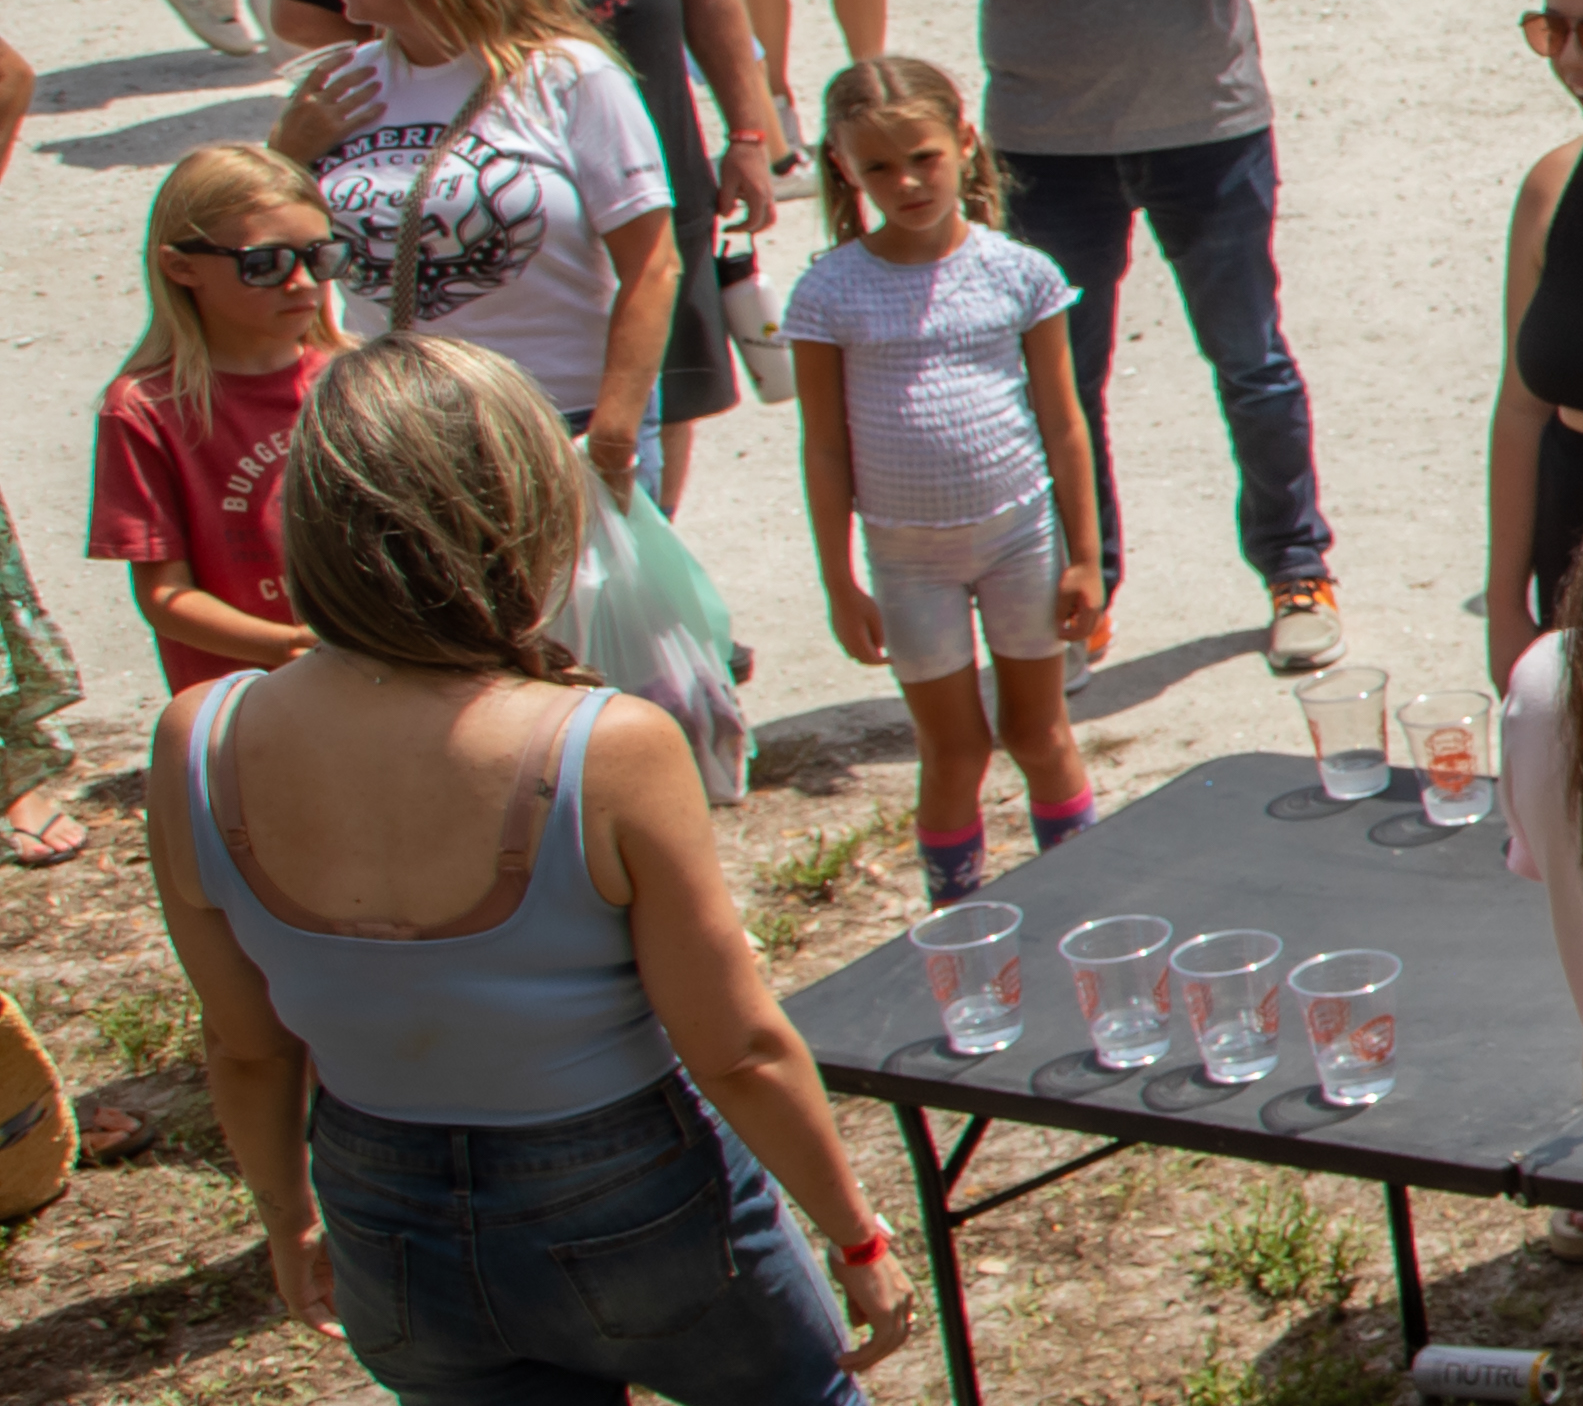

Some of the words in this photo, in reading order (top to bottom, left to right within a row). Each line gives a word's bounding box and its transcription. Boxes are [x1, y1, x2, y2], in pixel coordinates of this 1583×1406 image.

[316, 126, 498, 175] AMERIAN
[328, 169, 465, 214] Brery
[222, 431, 291, 512] BURGE
